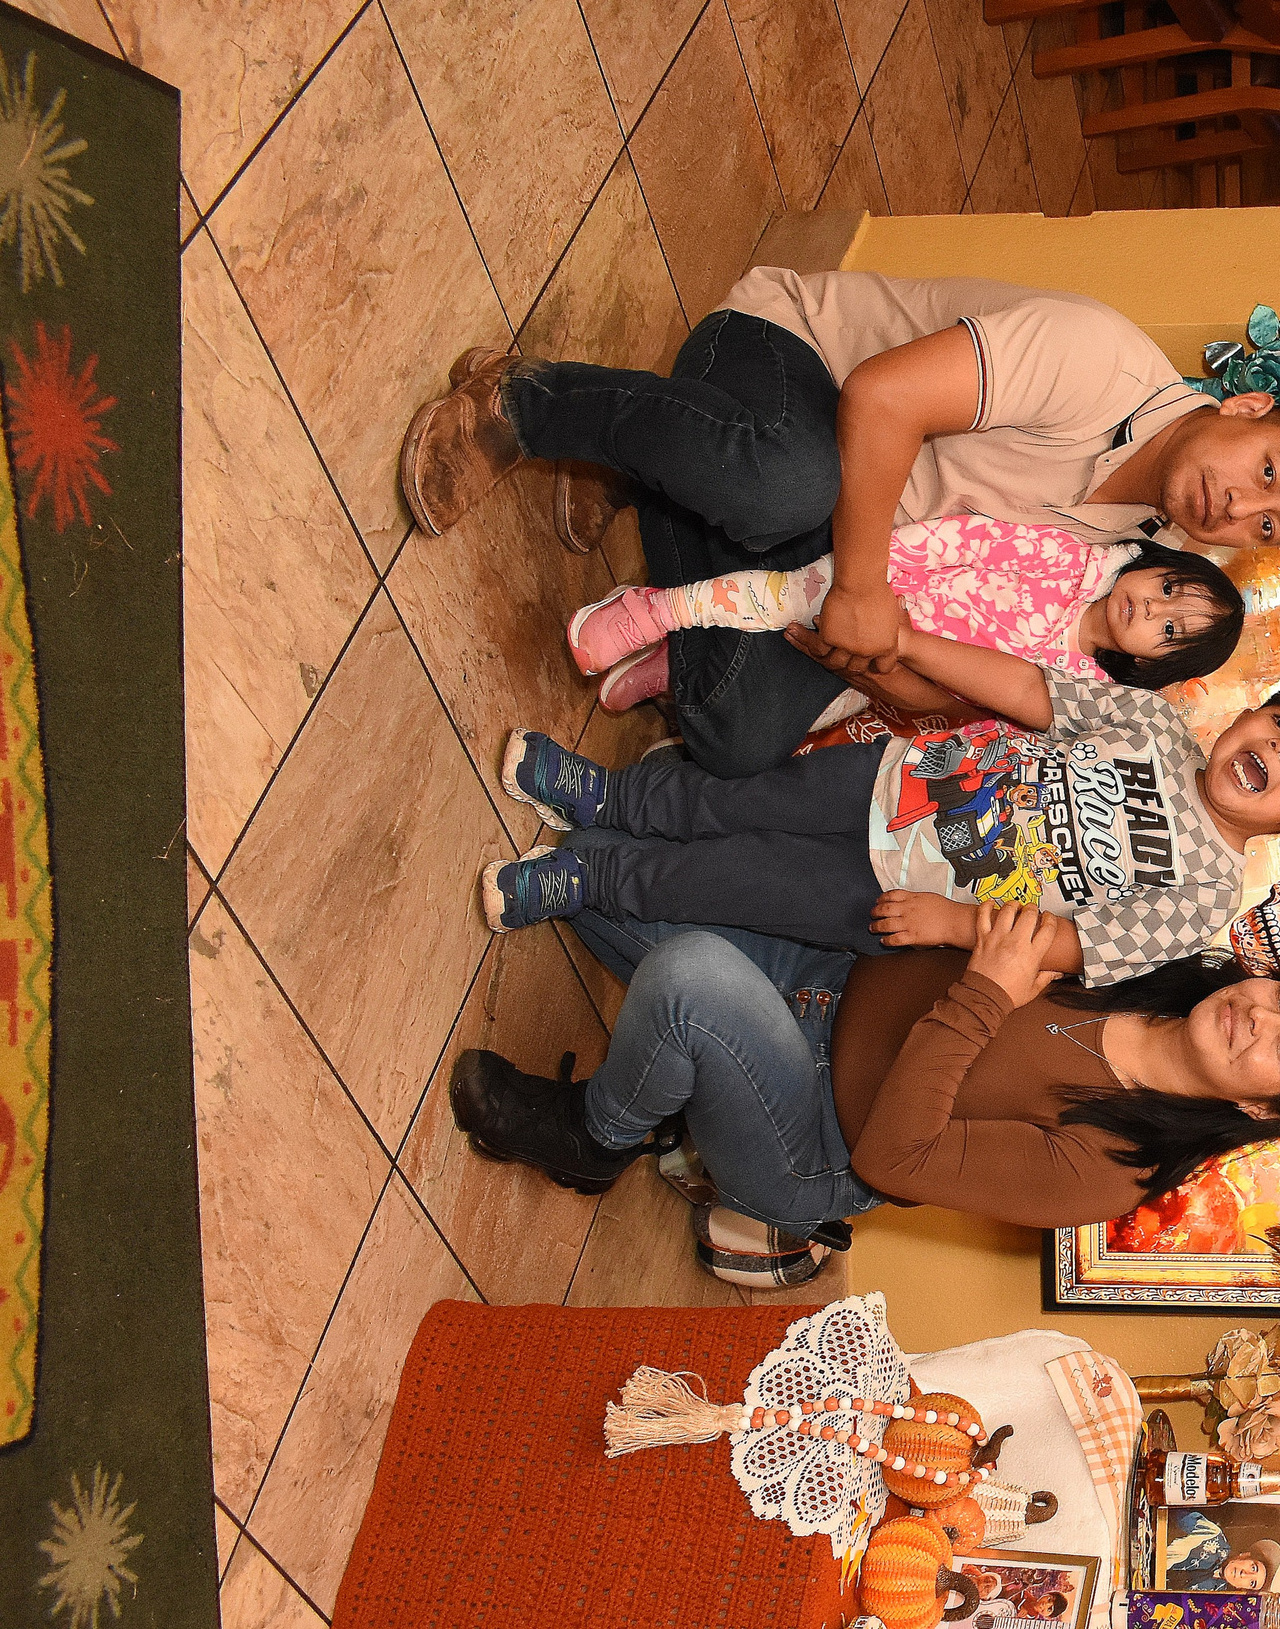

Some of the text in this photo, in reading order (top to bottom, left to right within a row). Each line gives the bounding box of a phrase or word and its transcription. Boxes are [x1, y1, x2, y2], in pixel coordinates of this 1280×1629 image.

[1043, 768, 1085, 889] RESCUE
[1069, 761, 1126, 888] Race
[1113, 757, 1176, 888] READY
[1185, 1457, 1202, 1496] Modelo
